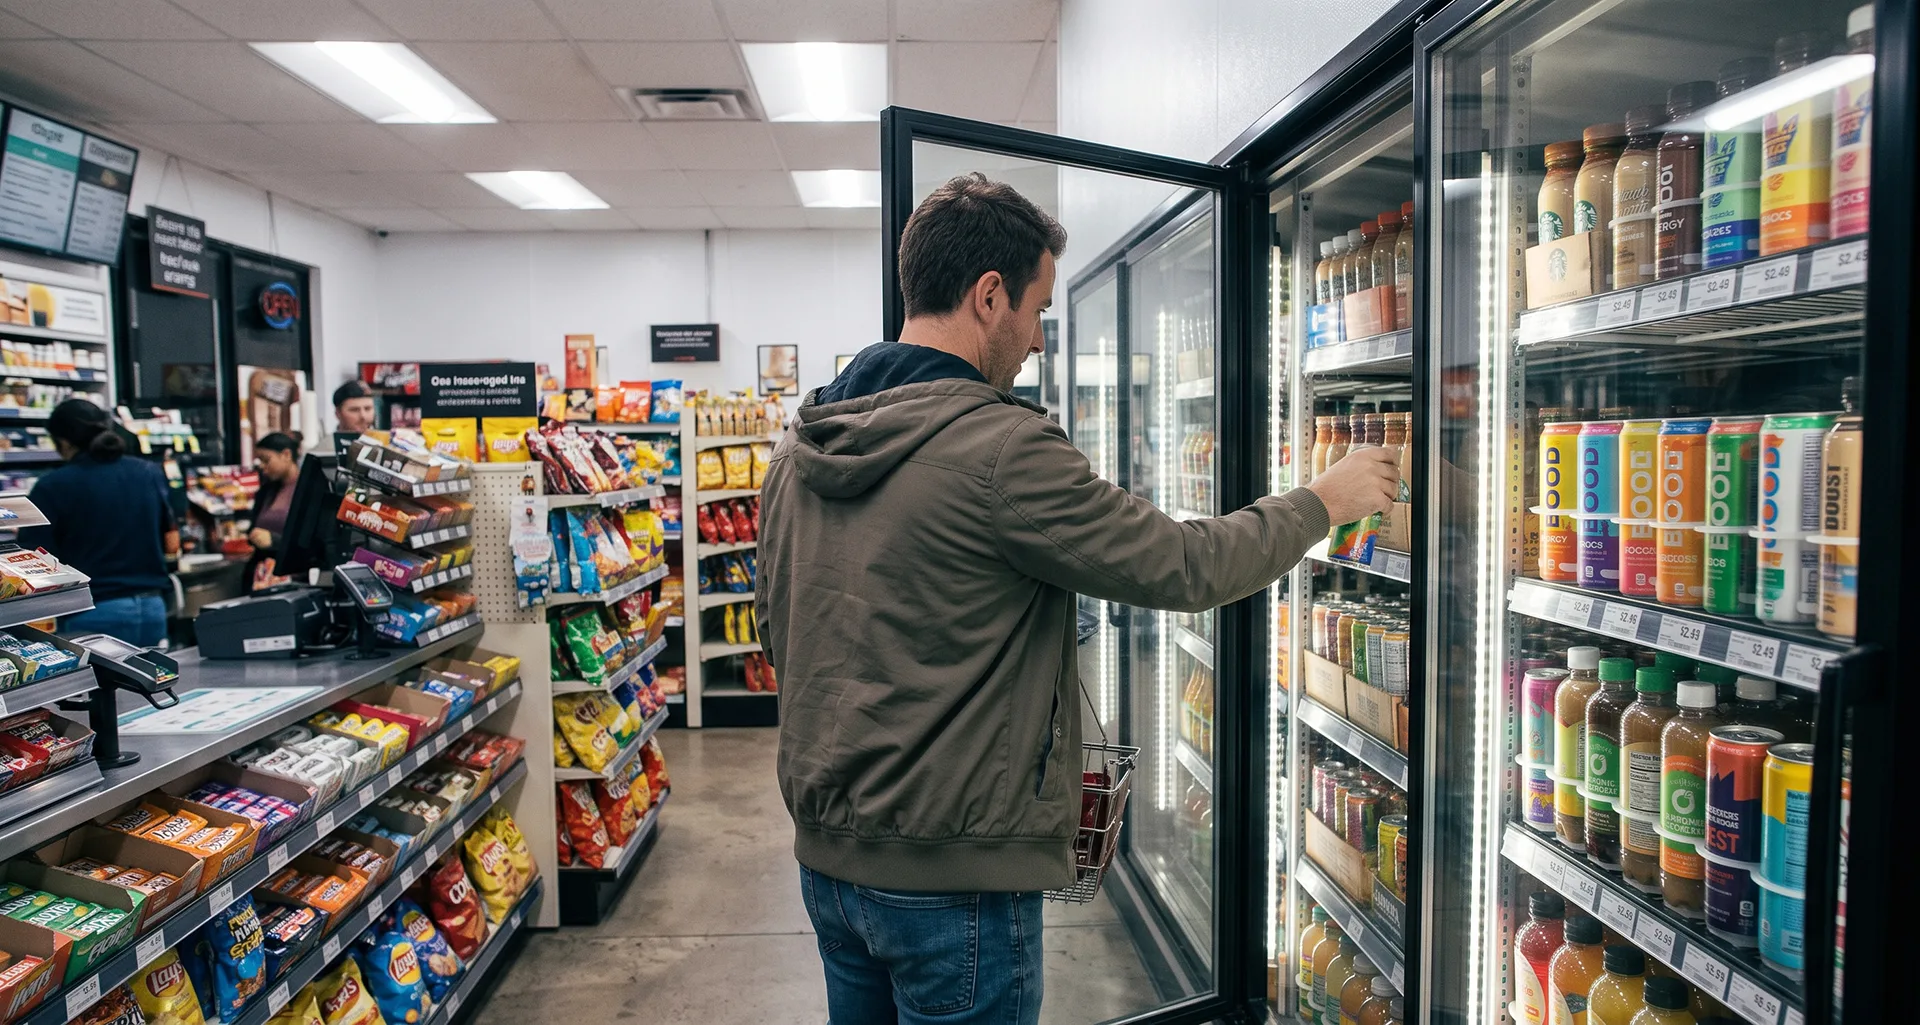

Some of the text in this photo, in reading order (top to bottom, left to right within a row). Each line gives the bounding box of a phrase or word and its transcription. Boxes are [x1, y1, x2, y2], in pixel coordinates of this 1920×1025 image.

[1764, 265, 1791, 281] $2.49
[1706, 278, 1730, 294] $2.49
[1751, 643, 1775, 659] $2.49
